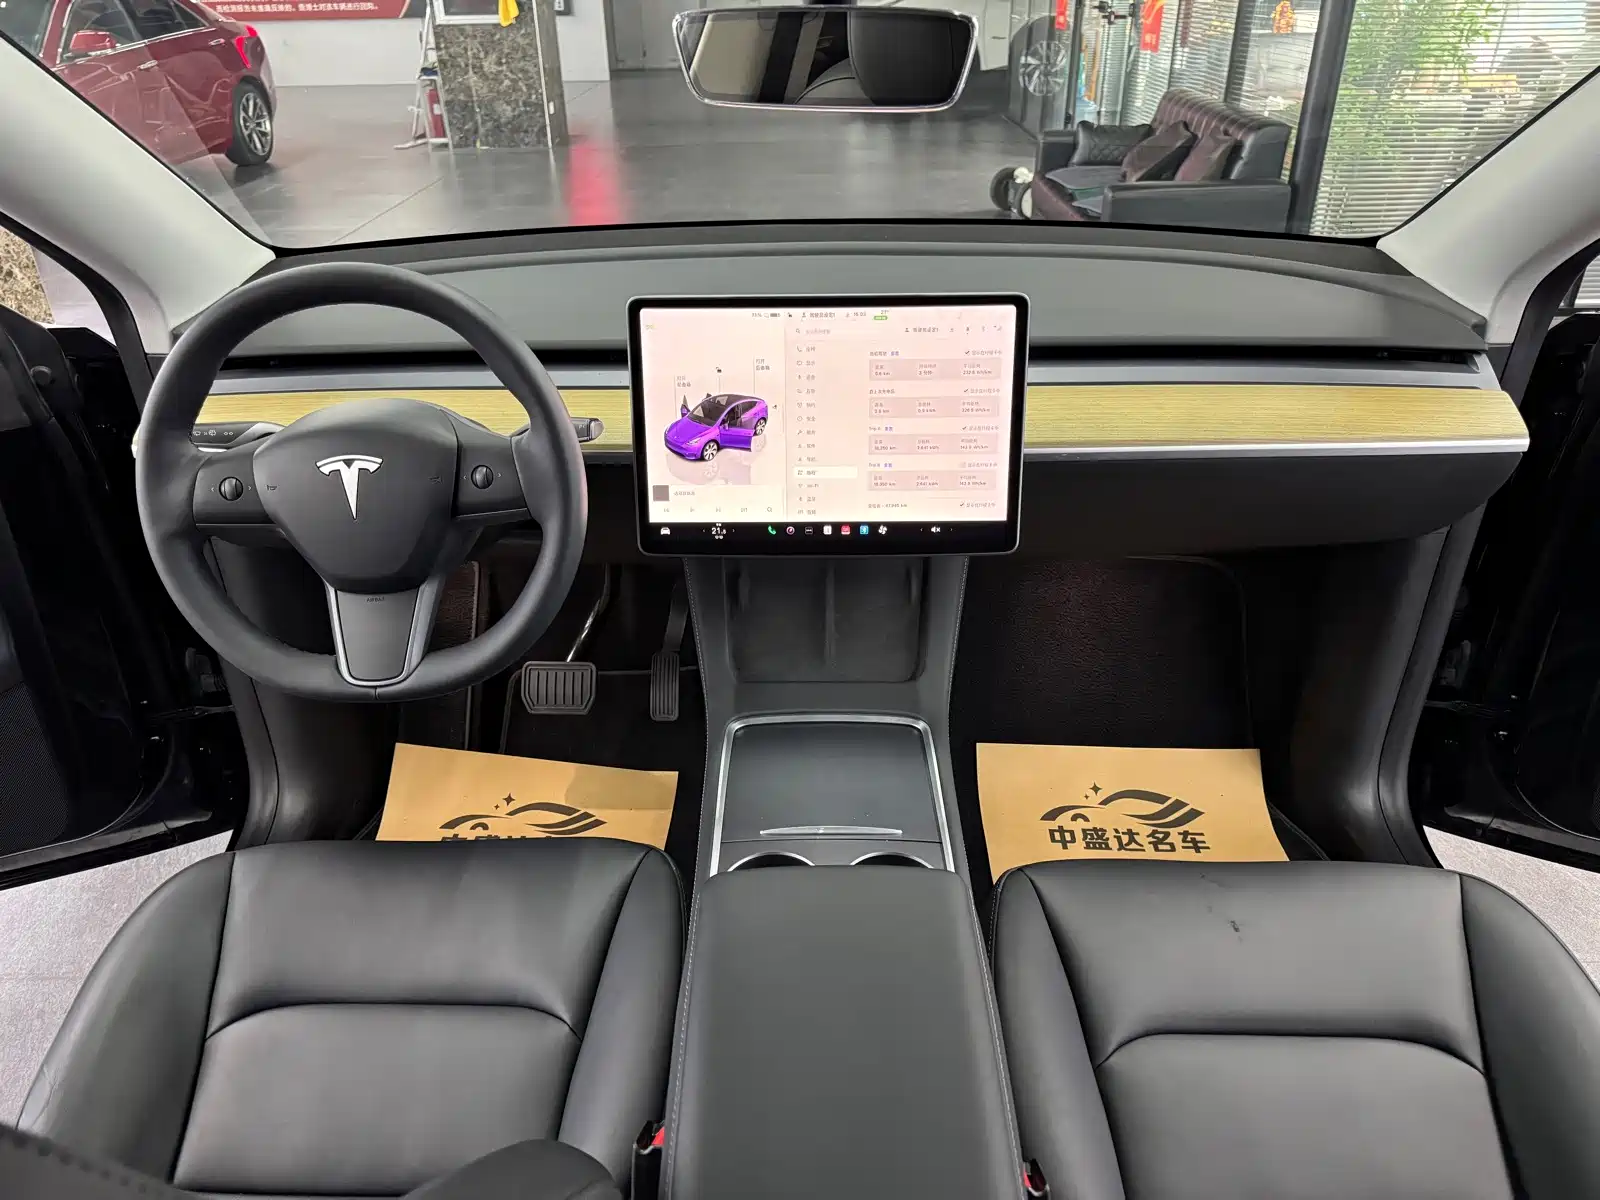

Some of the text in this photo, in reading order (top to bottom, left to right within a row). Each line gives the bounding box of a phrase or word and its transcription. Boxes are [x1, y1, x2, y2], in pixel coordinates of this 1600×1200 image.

[1048, 825, 1211, 854] 中盛达名车
